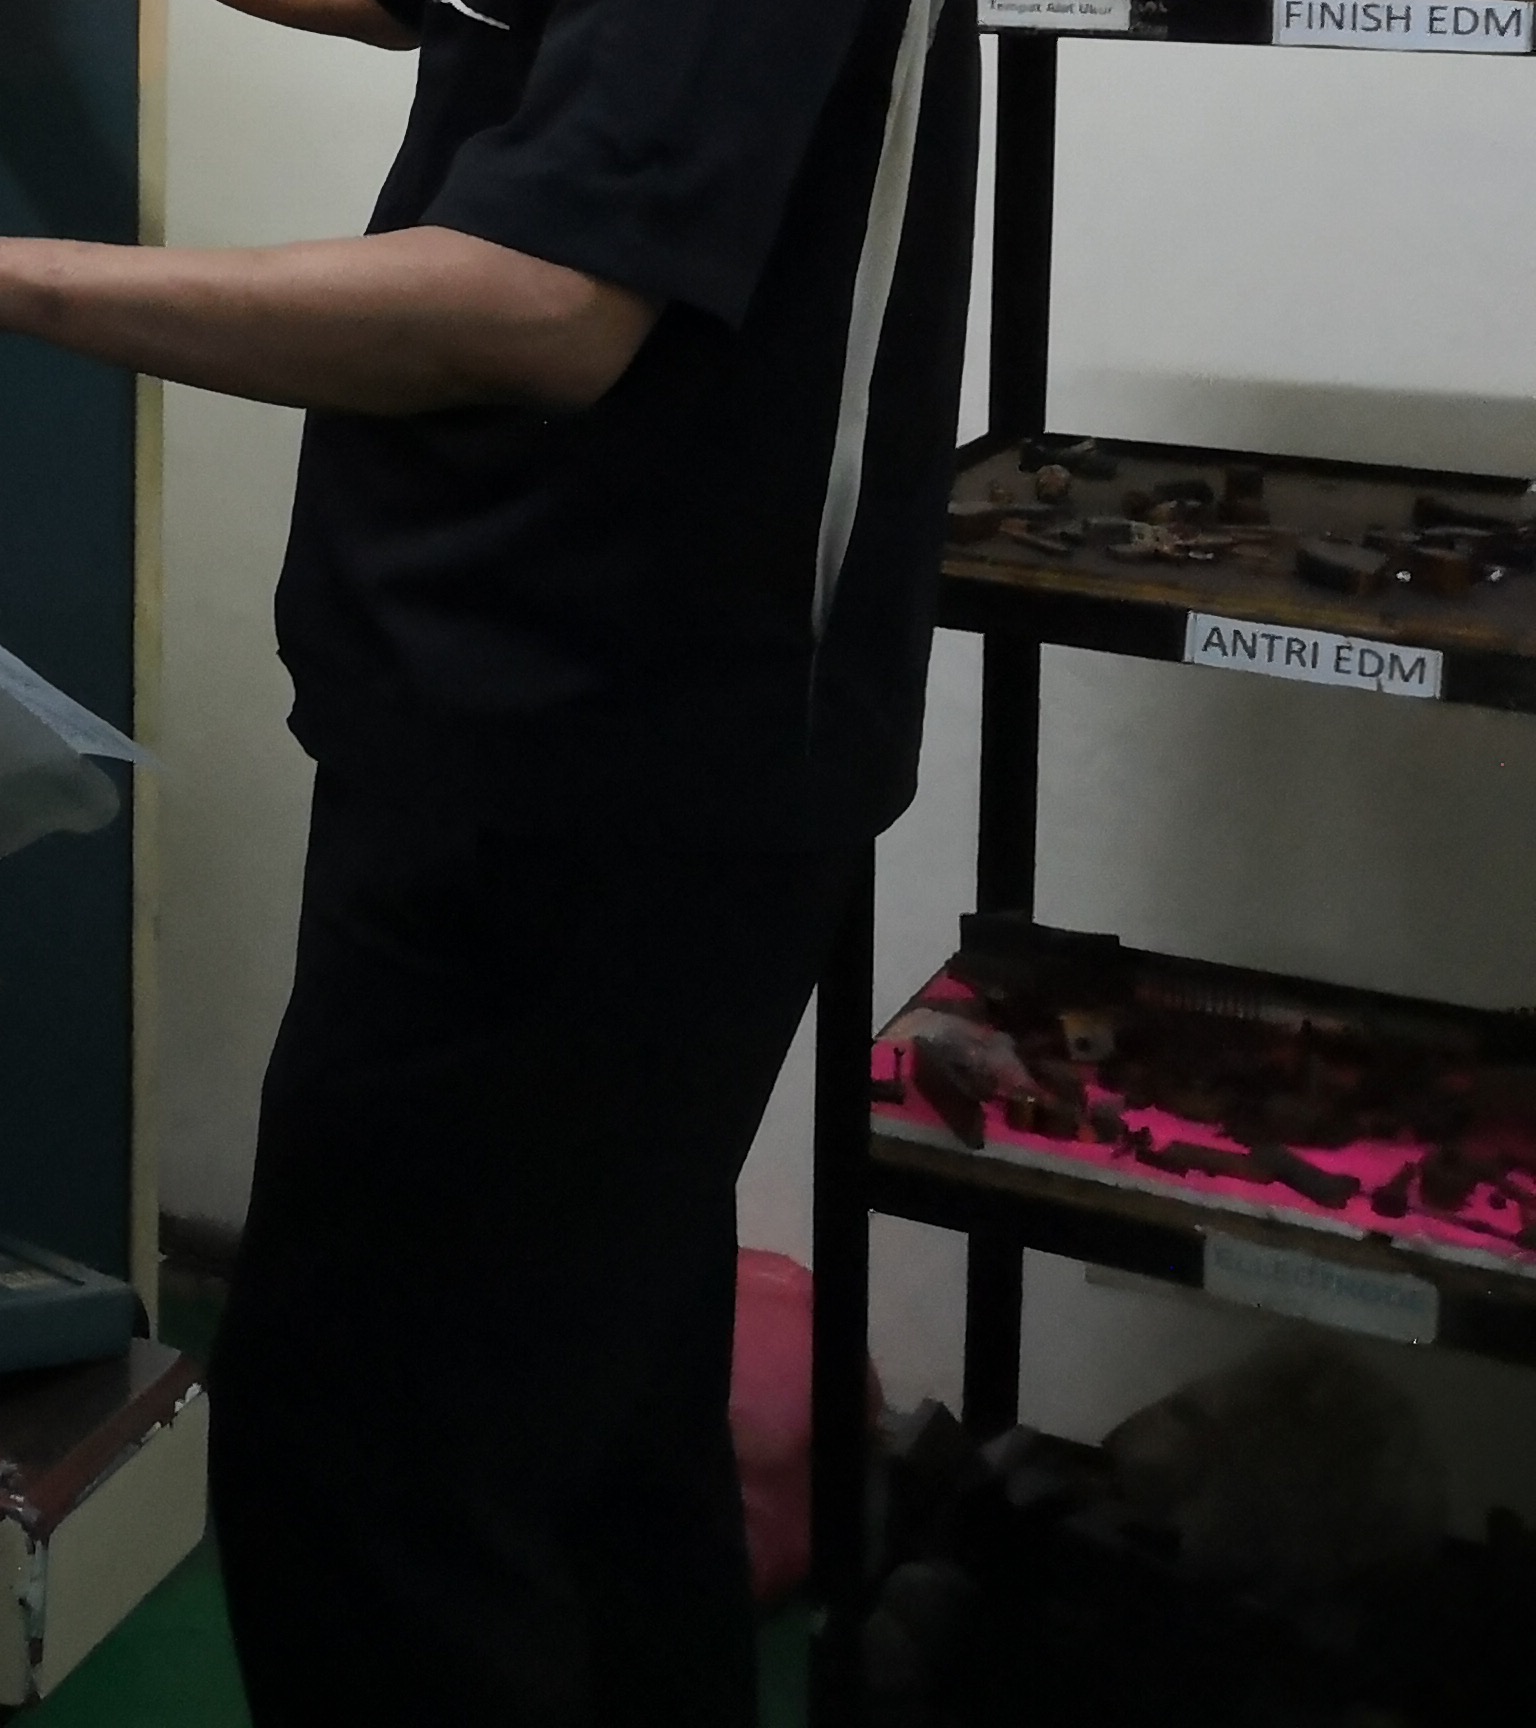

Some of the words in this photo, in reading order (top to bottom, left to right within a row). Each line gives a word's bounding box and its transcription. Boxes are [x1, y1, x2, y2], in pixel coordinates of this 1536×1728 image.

[1285, 0, 1411, 34] FINISH
[1429, 4, 1523, 38] EDM
[1201, 627, 1319, 669] ANTRI
[1333, 645, 1426, 685] EDM
